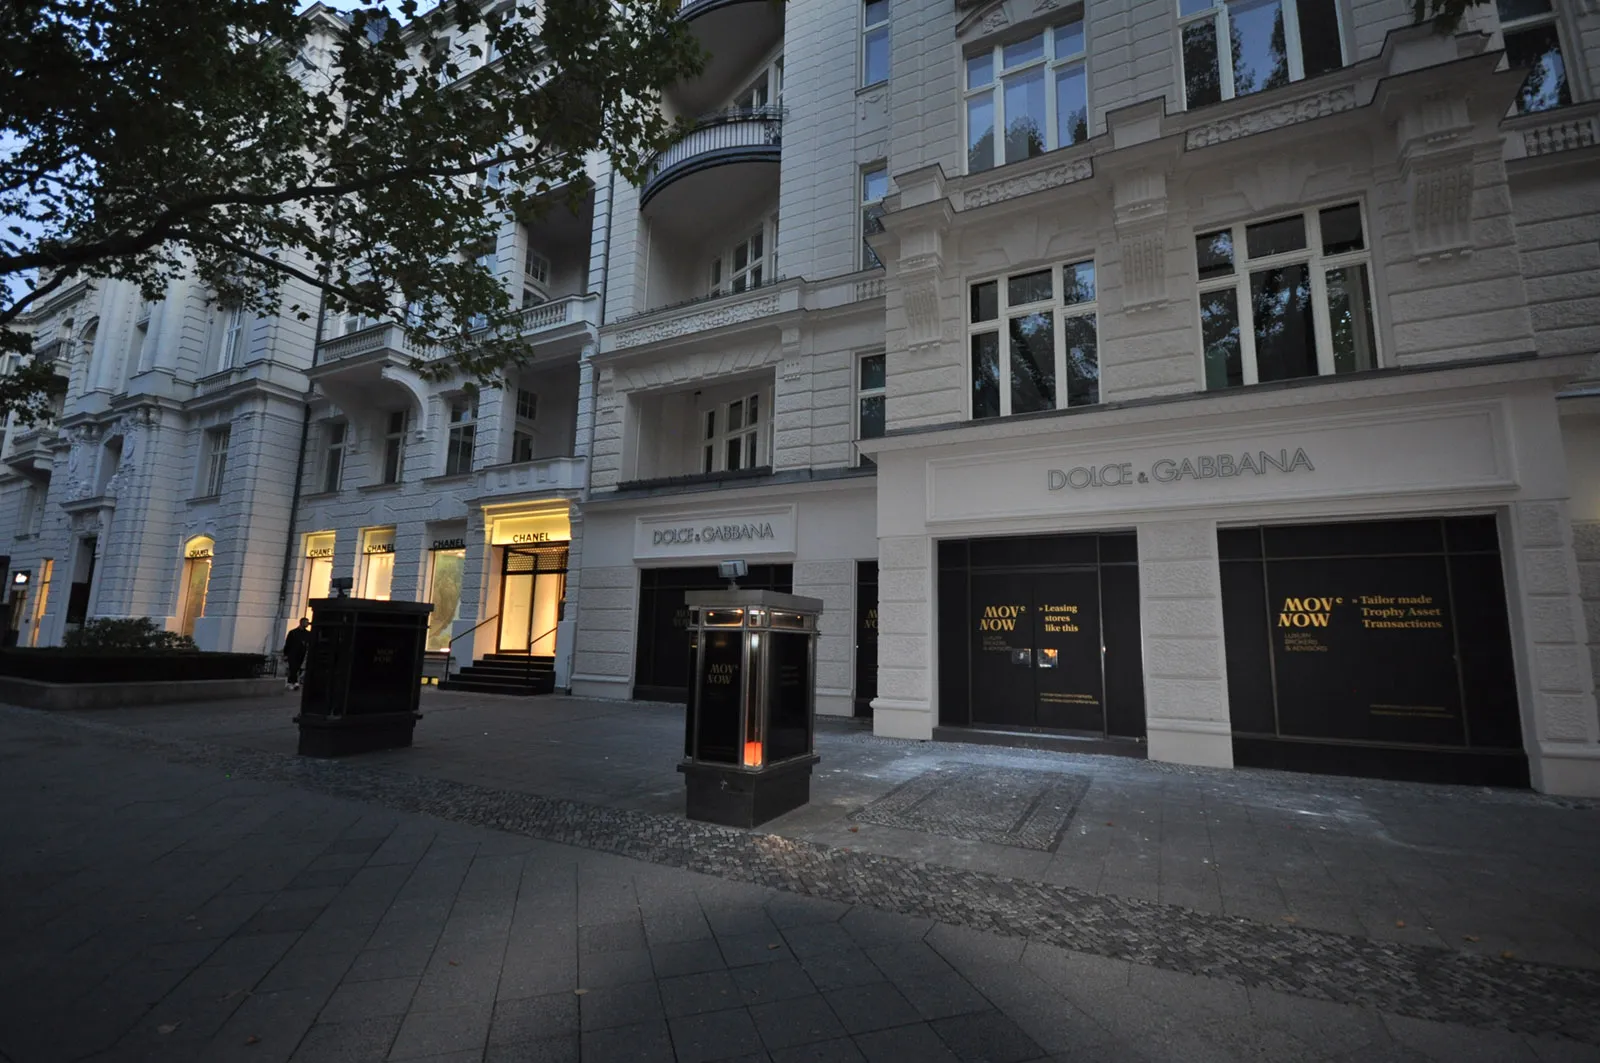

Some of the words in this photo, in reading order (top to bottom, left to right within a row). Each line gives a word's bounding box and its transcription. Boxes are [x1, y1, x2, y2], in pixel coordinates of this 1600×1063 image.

[1048, 463, 1133, 491] DOLCE
[1137, 472, 1149, 484] &
[1151, 447, 1315, 483] GABBANA
[513, 532, 551, 543] CHANEL
[653, 527, 694, 545] DOLCE
[702, 522, 775, 543] GABBANA
[366, 543, 395, 554] CHANEL
[433, 538, 466, 549] CHANEL
[1360, 595, 1395, 605] Tailor
[1397, 595, 1433, 605] made
[1044, 604, 1078, 614] Leasing
[1361, 607, 1406, 619] Trophy
[1407, 607, 1441, 617] Asset
[979, 619, 1016, 631] NOW
[1277, 612, 1331, 628] NOW
[1362, 619, 1444, 629] Transactions
[1044, 624, 1061, 632] like
[1062, 624, 1079, 632] this
